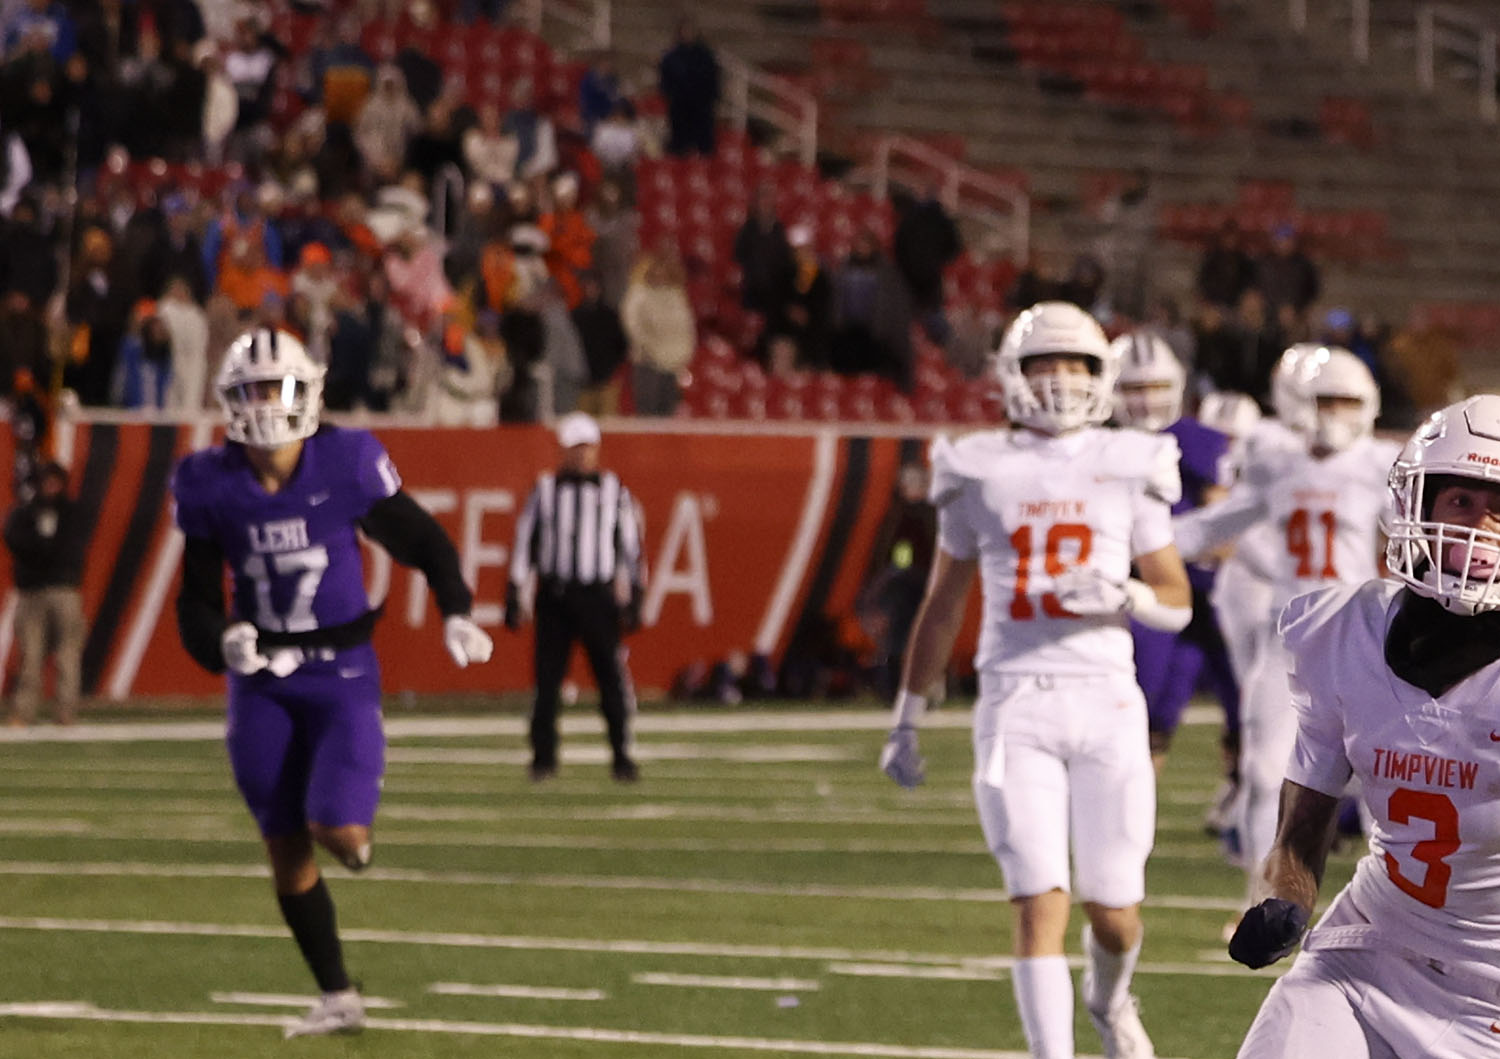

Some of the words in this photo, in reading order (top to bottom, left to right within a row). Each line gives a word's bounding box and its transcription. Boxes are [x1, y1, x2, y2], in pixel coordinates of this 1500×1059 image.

[249, 517, 310, 551] LEHI
[244, 545, 328, 633] 17
[1373, 748, 1479, 790] TIMPVIEW
[1385, 787, 1461, 909] 3
